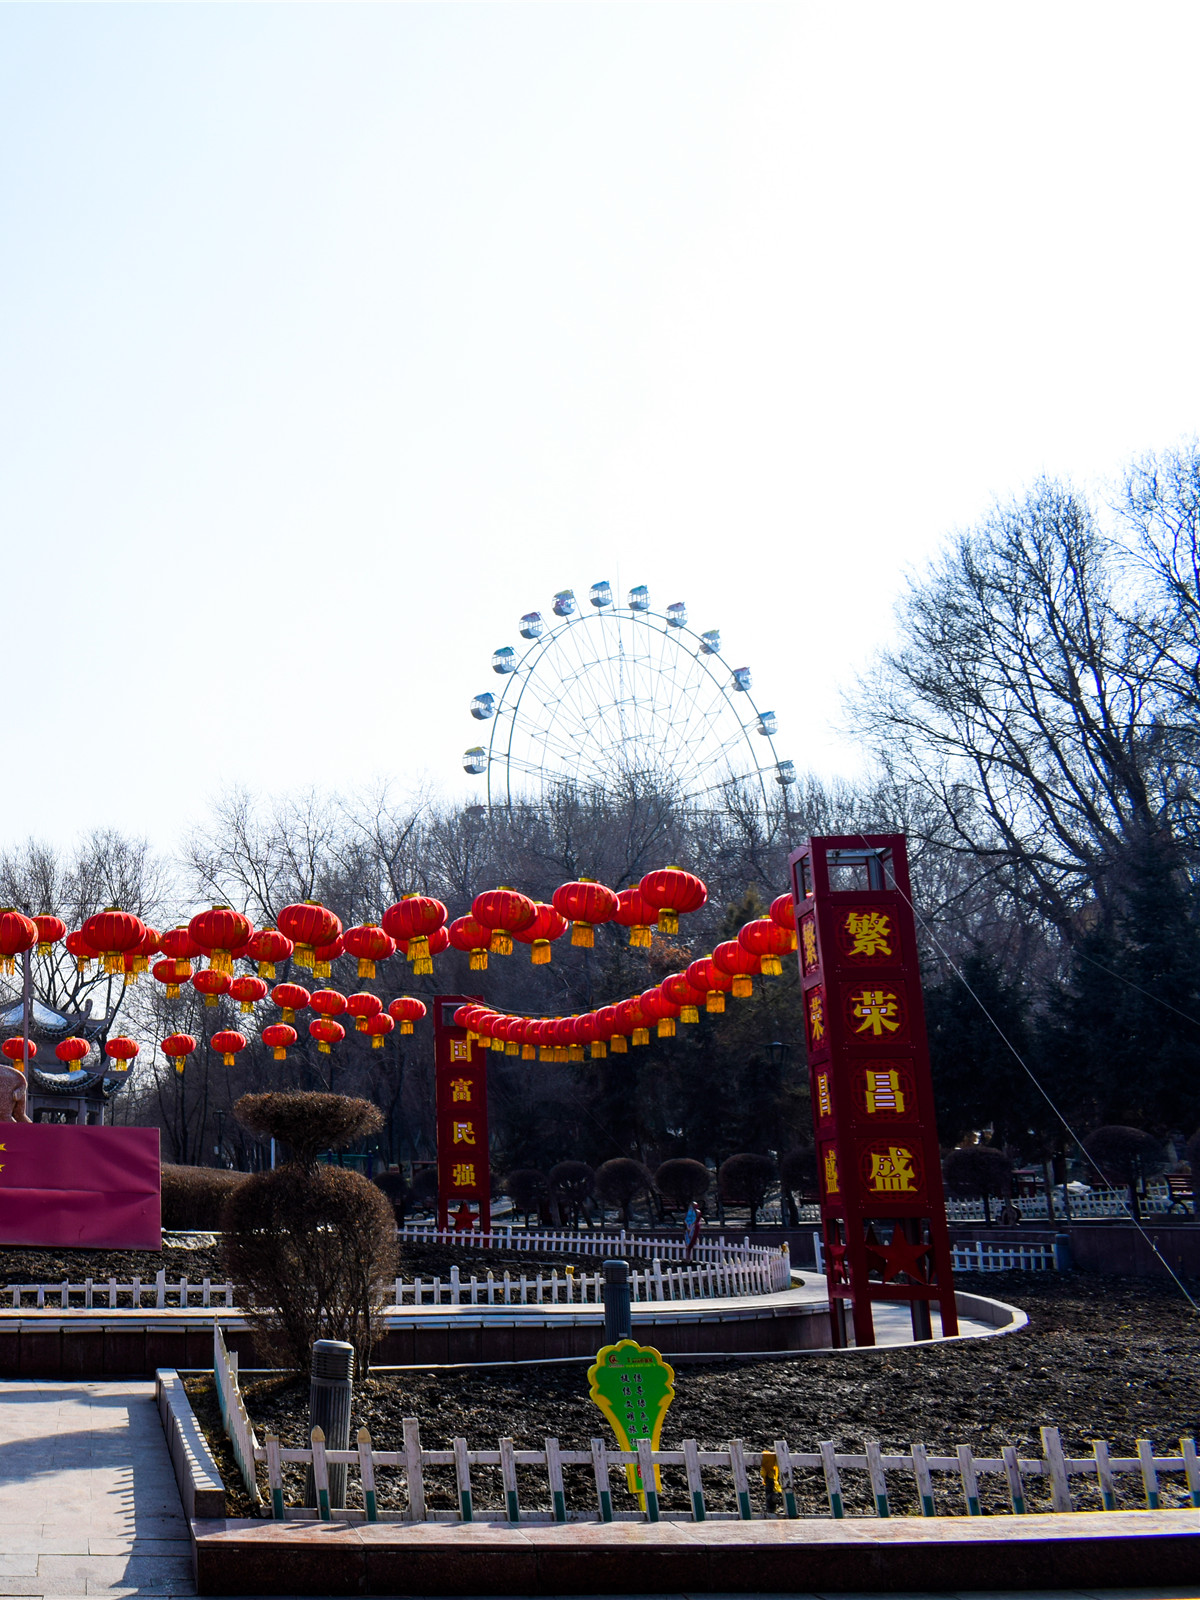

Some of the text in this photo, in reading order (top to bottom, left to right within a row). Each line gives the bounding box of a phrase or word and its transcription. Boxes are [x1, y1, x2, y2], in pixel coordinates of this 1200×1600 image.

[449, 1038, 477, 1187] 国富民强
[801, 920, 841, 1195] 繁荣昌盛
[845, 911, 918, 1193] 繁荣昌盛
